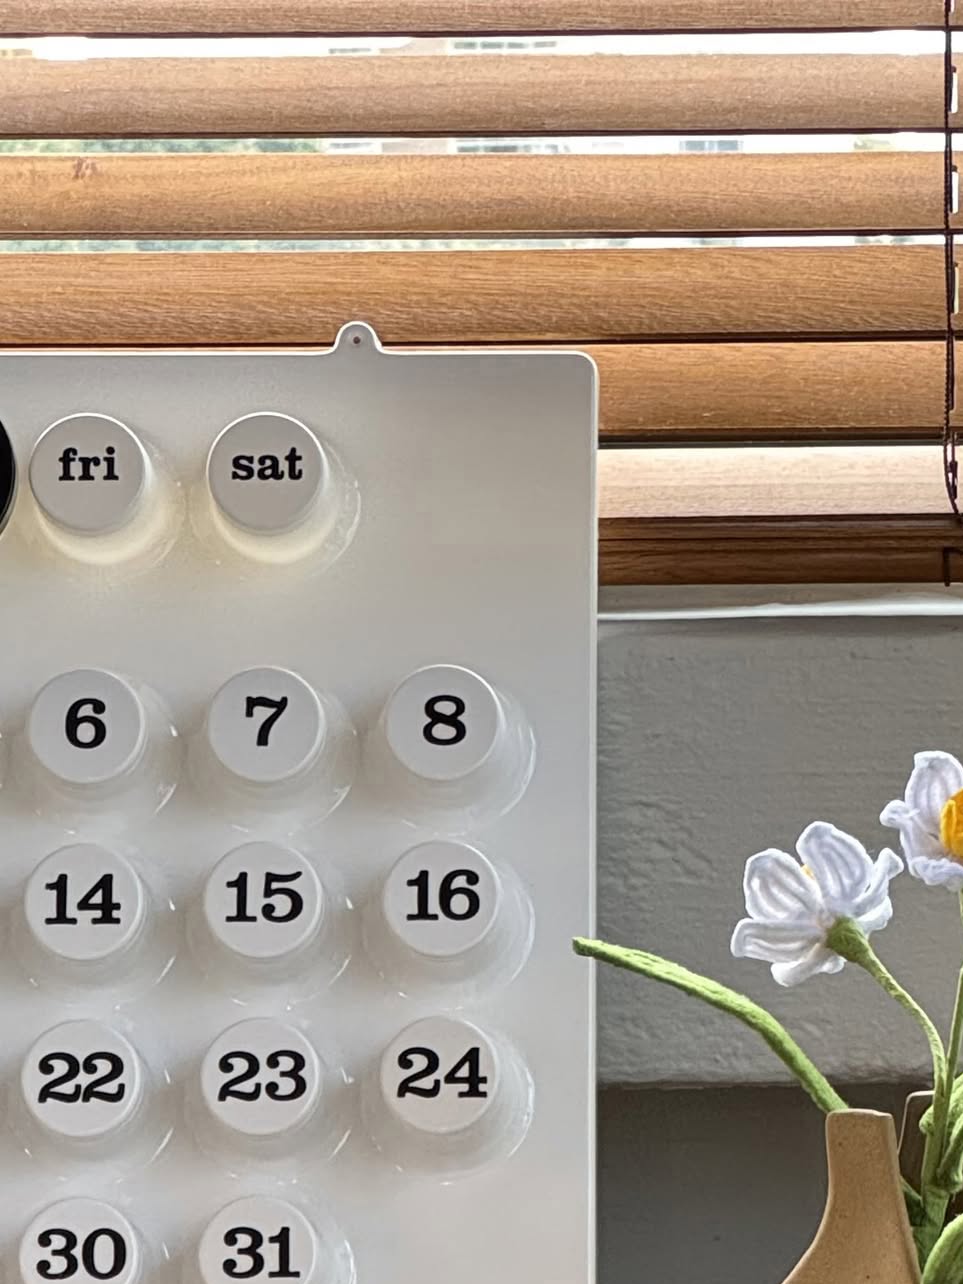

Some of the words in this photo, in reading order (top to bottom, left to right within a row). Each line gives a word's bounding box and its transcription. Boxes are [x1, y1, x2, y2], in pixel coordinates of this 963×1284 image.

[58, 446, 119, 482] fri
[231, 446, 303, 481] sat
[65, 697, 107, 749] 6
[245, 696, 288, 747] 7
[422, 694, 467, 746] 8
[44, 873, 122, 925] 14
[225, 871, 304, 923] 15
[406, 869, 480, 921] 16
[37, 1051, 126, 1104] 22
[217, 1049, 307, 1102] 23
[396, 1046, 488, 1099] 24
[36, 1227, 127, 1280] 30
[222, 1226, 301, 1279] 31
